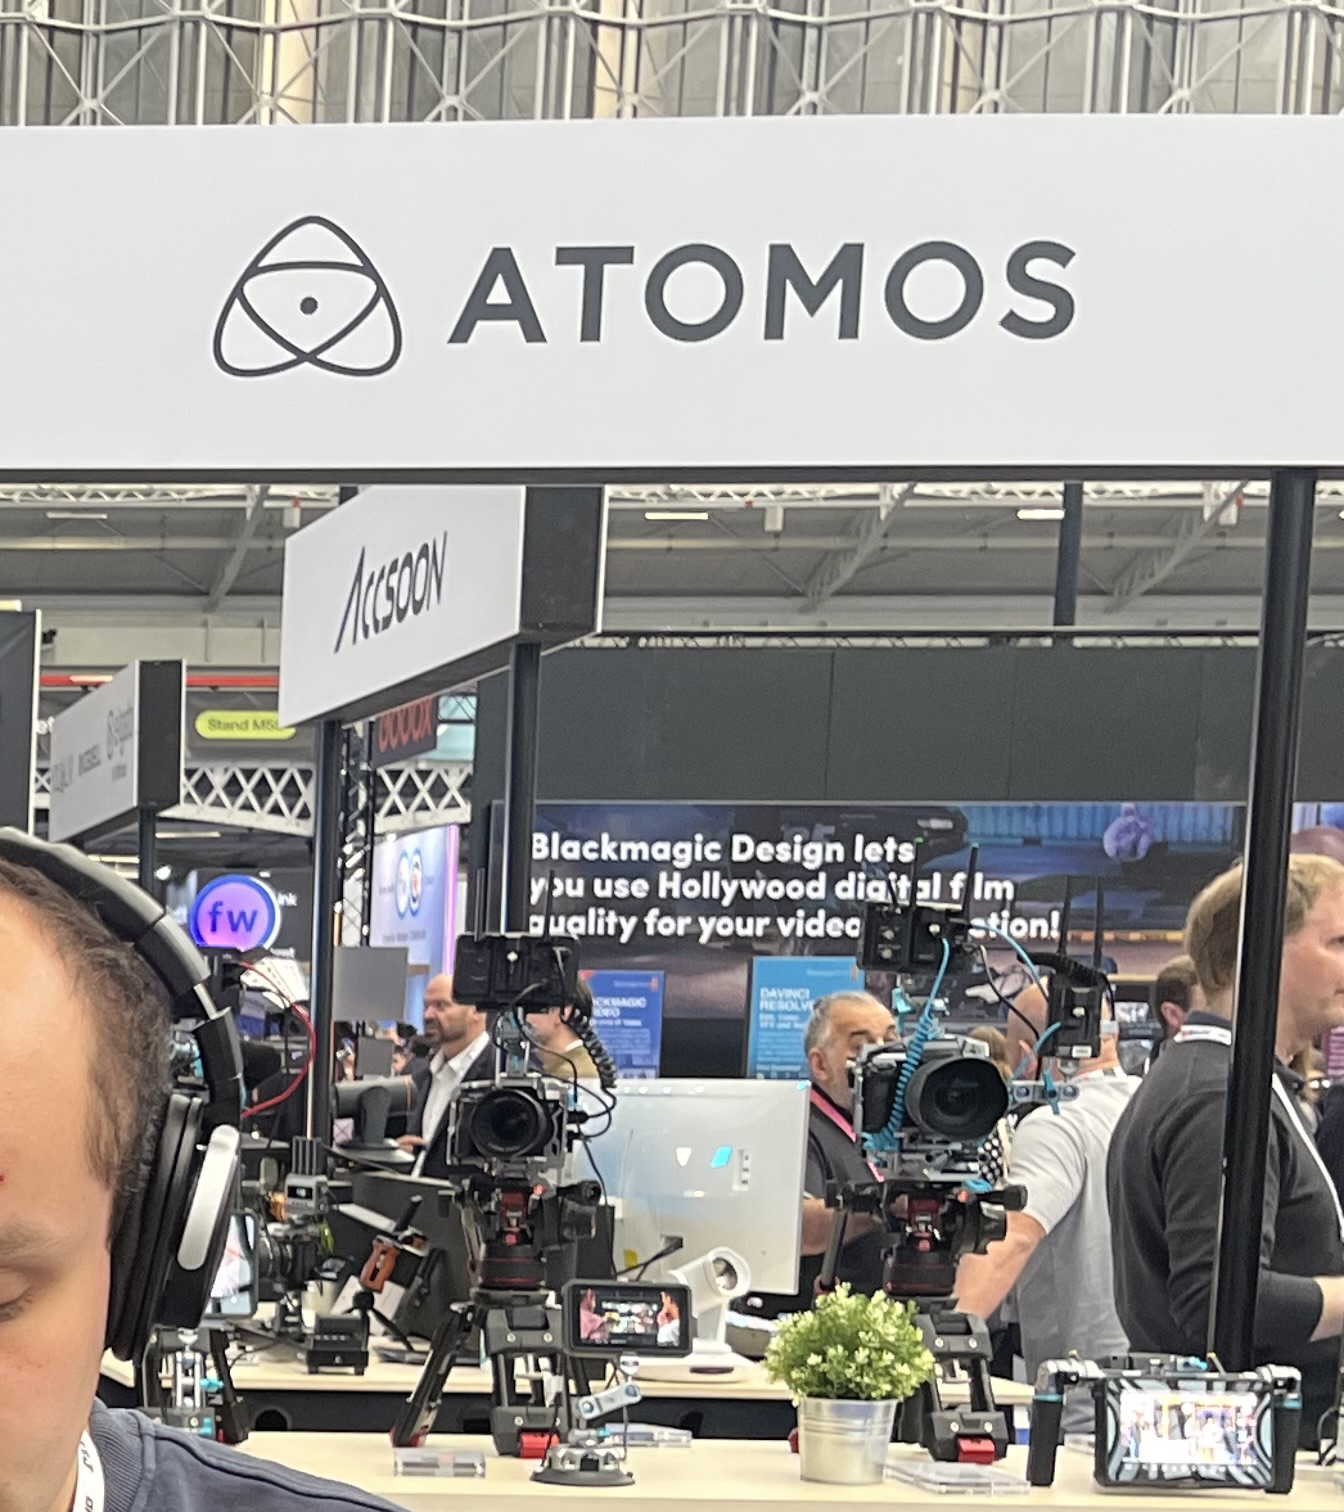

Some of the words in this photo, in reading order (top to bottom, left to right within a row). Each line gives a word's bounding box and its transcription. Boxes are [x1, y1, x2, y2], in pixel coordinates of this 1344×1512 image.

[447, 240, 1077, 344] ATOMOS
[207, 718, 249, 732] Stand
[531, 832, 722, 869] Blackmagic
[731, 833, 845, 870] Design
[854, 833, 915, 863] lets
[593, 877, 650, 899] use
[658, 870, 827, 907] Hollywood
[949, 872, 1015, 901] flm
[208, 901, 258, 932] fw
[644, 907, 692, 937] for
[697, 915, 771, 945] your
